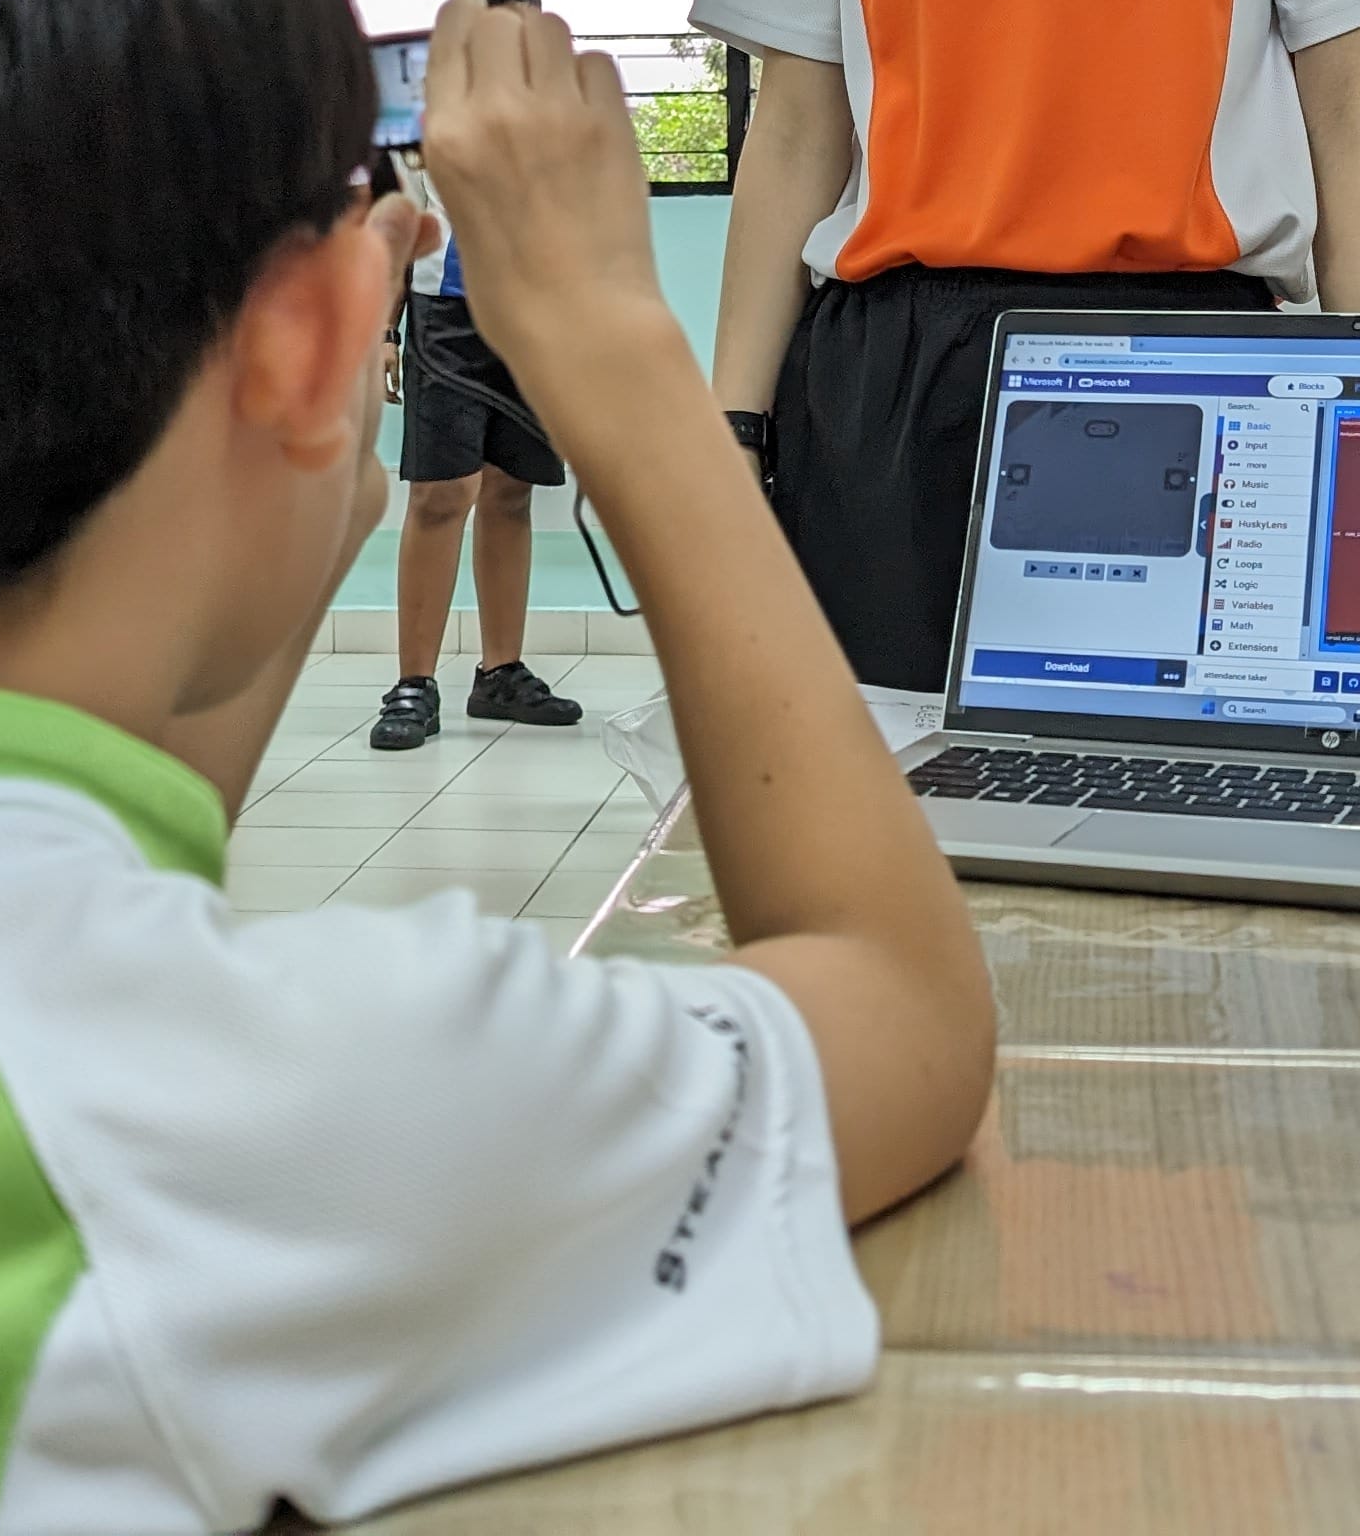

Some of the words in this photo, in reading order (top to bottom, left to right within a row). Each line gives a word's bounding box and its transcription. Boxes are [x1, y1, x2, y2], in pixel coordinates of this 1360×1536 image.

[1023, 377, 1063, 387] Microsoft
[1299, 383, 1325, 391] Blocks
[1247, 422, 1271, 431] Basic
[1245, 441, 1268, 451] Input
[1242, 480, 1269, 489] Music
[1240, 500, 1257, 509] Led
[1238, 520, 1288, 530] HuskyLens
[1237, 540, 1262, 549] Radio
[1235, 561, 1263, 570] Loops
[1233, 580, 1258, 590] Logic
[1232, 600, 1273, 610] Variables
[1230, 622, 1253, 630] Math
[1228, 642, 1278, 652] Extensions
[1045, 661, 1090, 673] Download
[1204, 672, 1246, 681] attendance
[1248, 673, 1267, 682] taker
[1242, 706, 1267, 714] Search
[1323, 731, 1339, 748] hp
